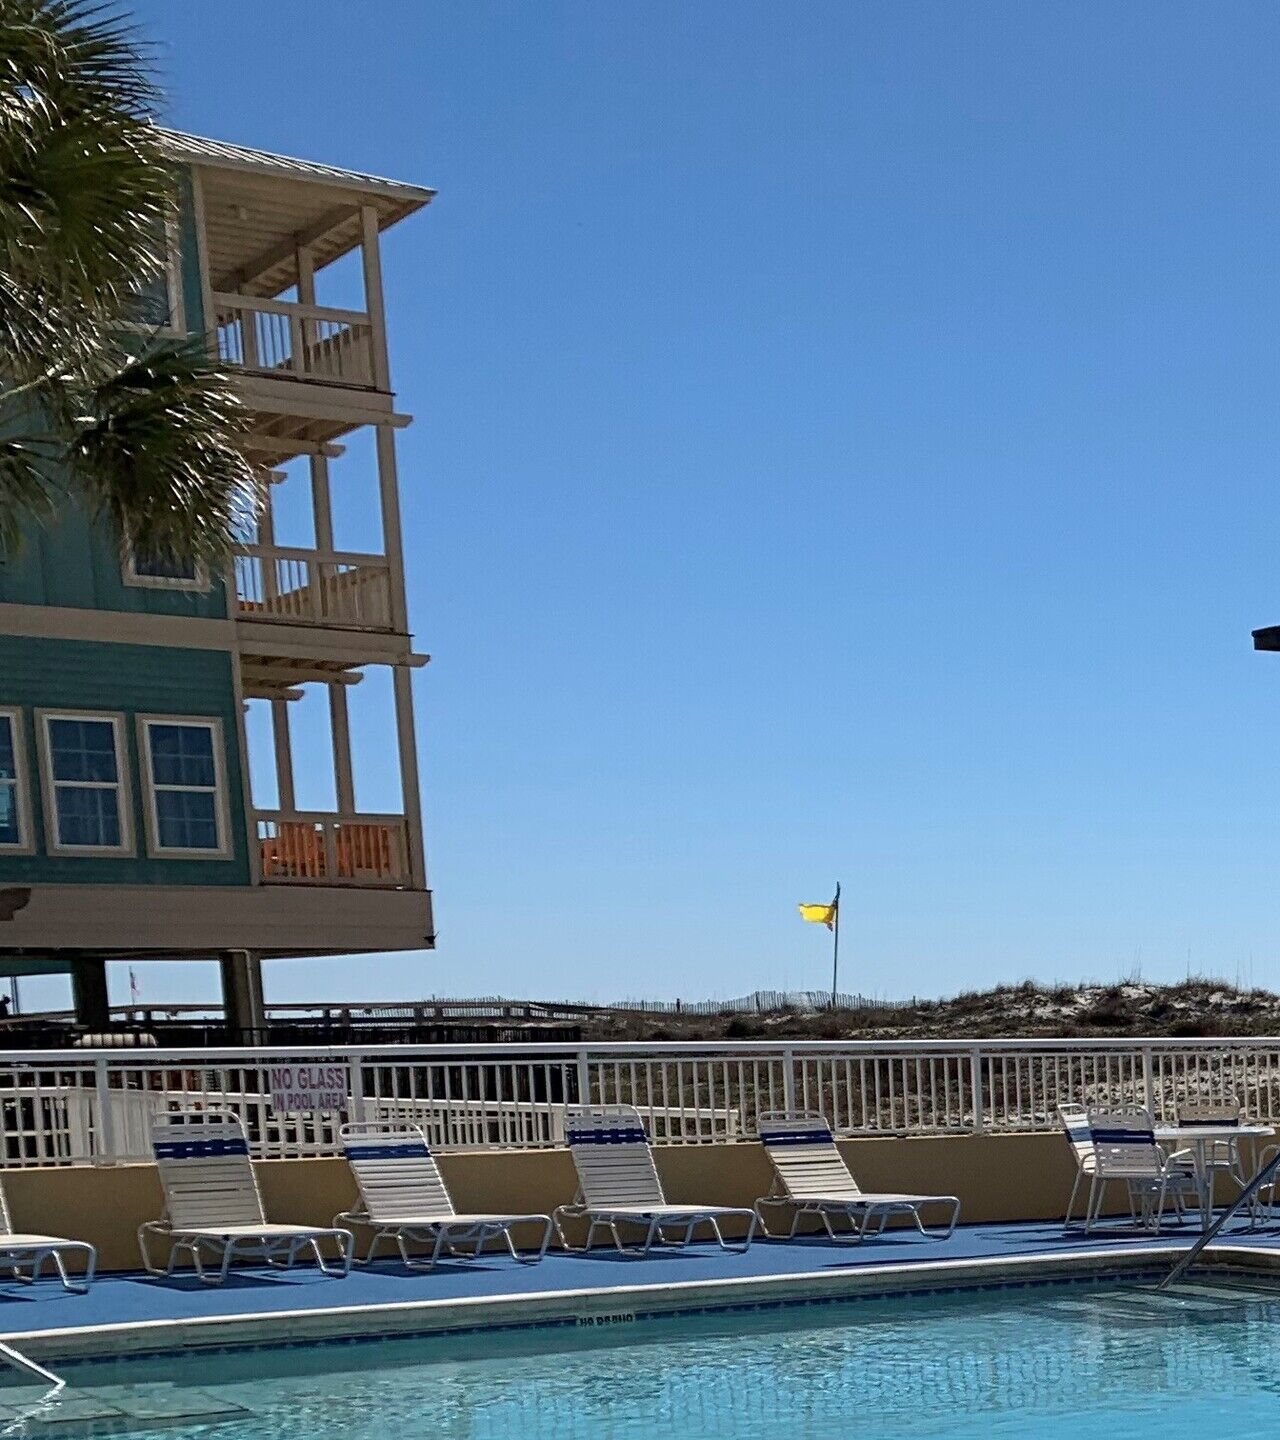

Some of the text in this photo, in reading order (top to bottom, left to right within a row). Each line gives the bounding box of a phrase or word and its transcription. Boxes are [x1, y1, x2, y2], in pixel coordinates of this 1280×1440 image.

[271, 1067, 344, 1090] NO GLASS
[273, 1092, 346, 1111] IN POOL AREA
